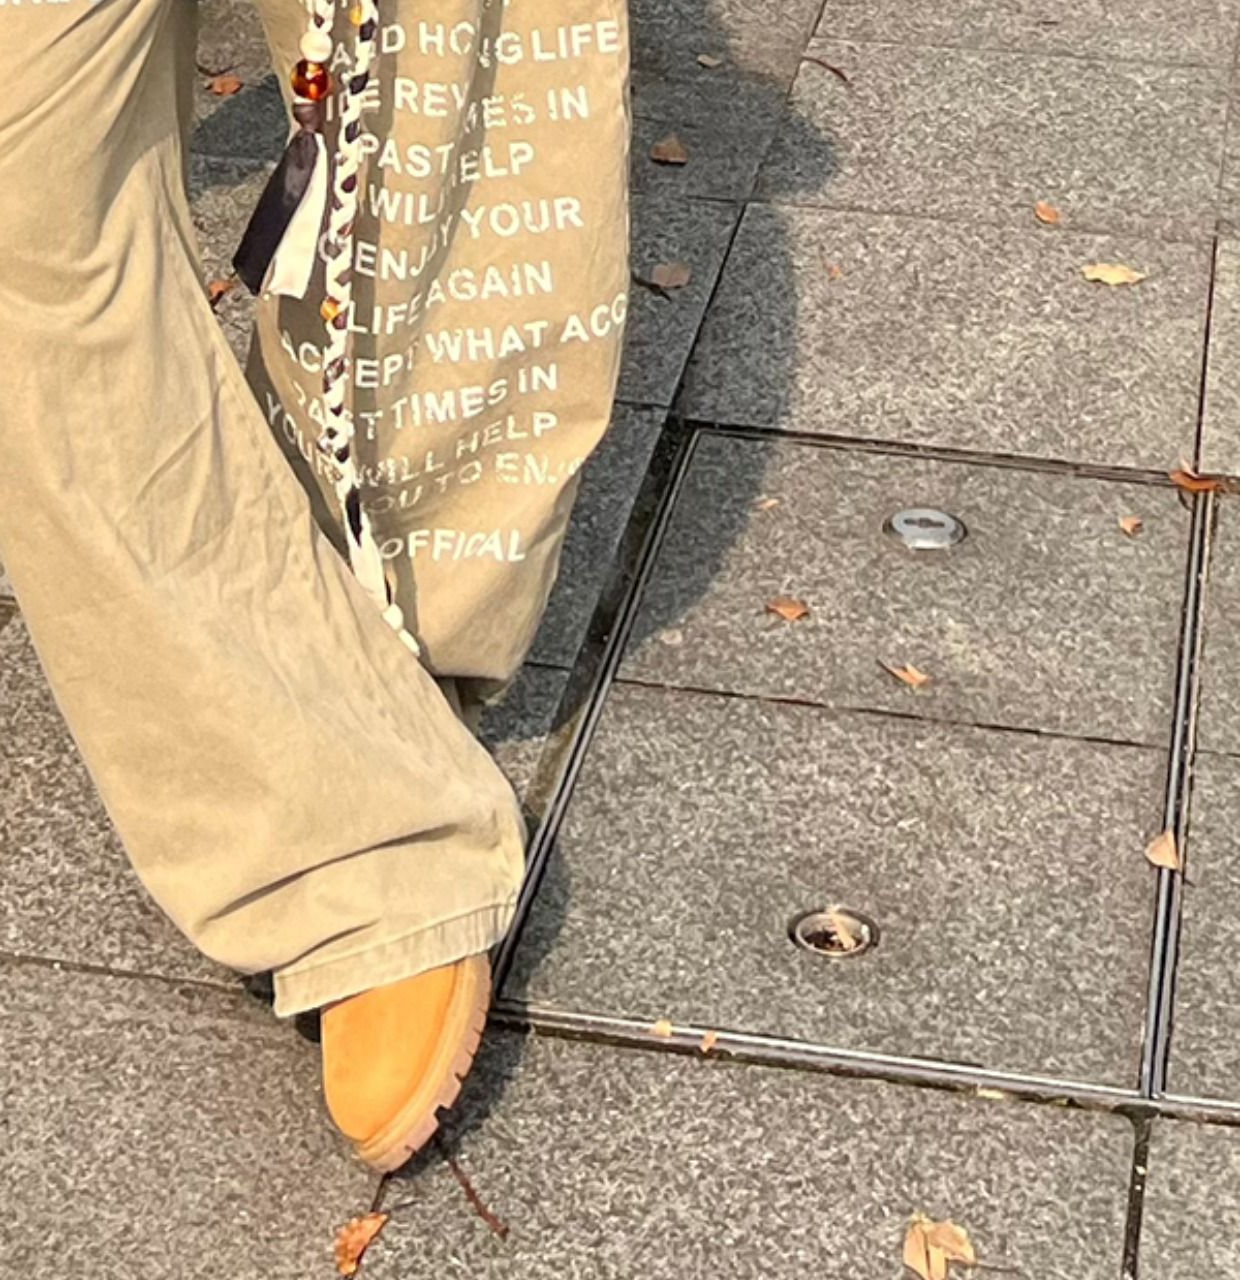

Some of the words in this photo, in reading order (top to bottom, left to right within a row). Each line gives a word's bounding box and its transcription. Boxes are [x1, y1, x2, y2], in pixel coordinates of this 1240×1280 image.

[533, 21, 620, 62] LIFE
[357, 132, 456, 178] PAST
[546, 86, 590, 121] IN
[460, 197, 584, 239] YOUR
[425, 260, 553, 309] AGAIN
[425, 320, 549, 364] WHAT
[391, 377, 509, 431] TIMES
[517, 363, 559, 395] IN
[457, 411, 559, 460] HELP
